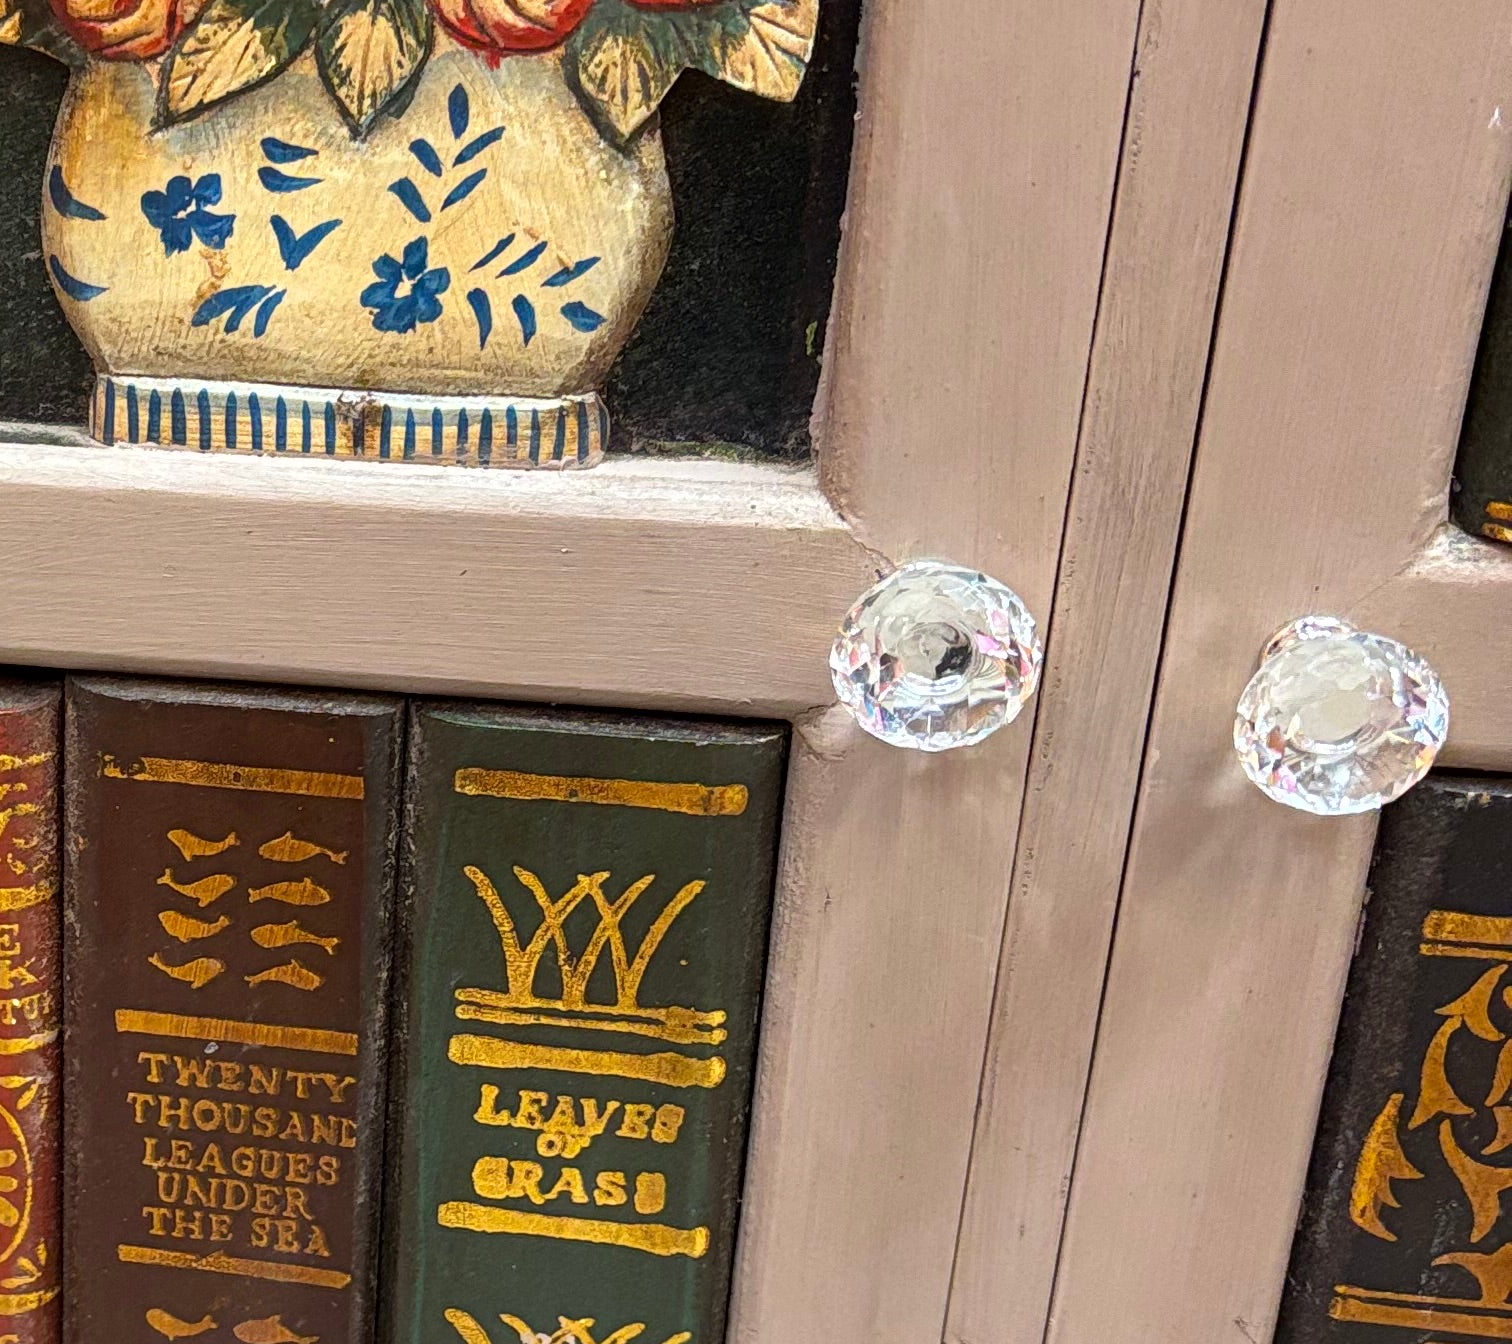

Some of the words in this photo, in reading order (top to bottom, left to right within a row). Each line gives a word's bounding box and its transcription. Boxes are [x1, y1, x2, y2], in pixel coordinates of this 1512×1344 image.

[137, 1051, 357, 1103] TWENTY
[126, 1092, 358, 1148] THOUSAND
[473, 1084, 685, 1143] LEAVES
[142, 1137, 340, 1185] LEAGUES
[157, 1171, 315, 1220] UNDER
[142, 1206, 233, 1241] THE
[250, 1217, 331, 1257] SEA
